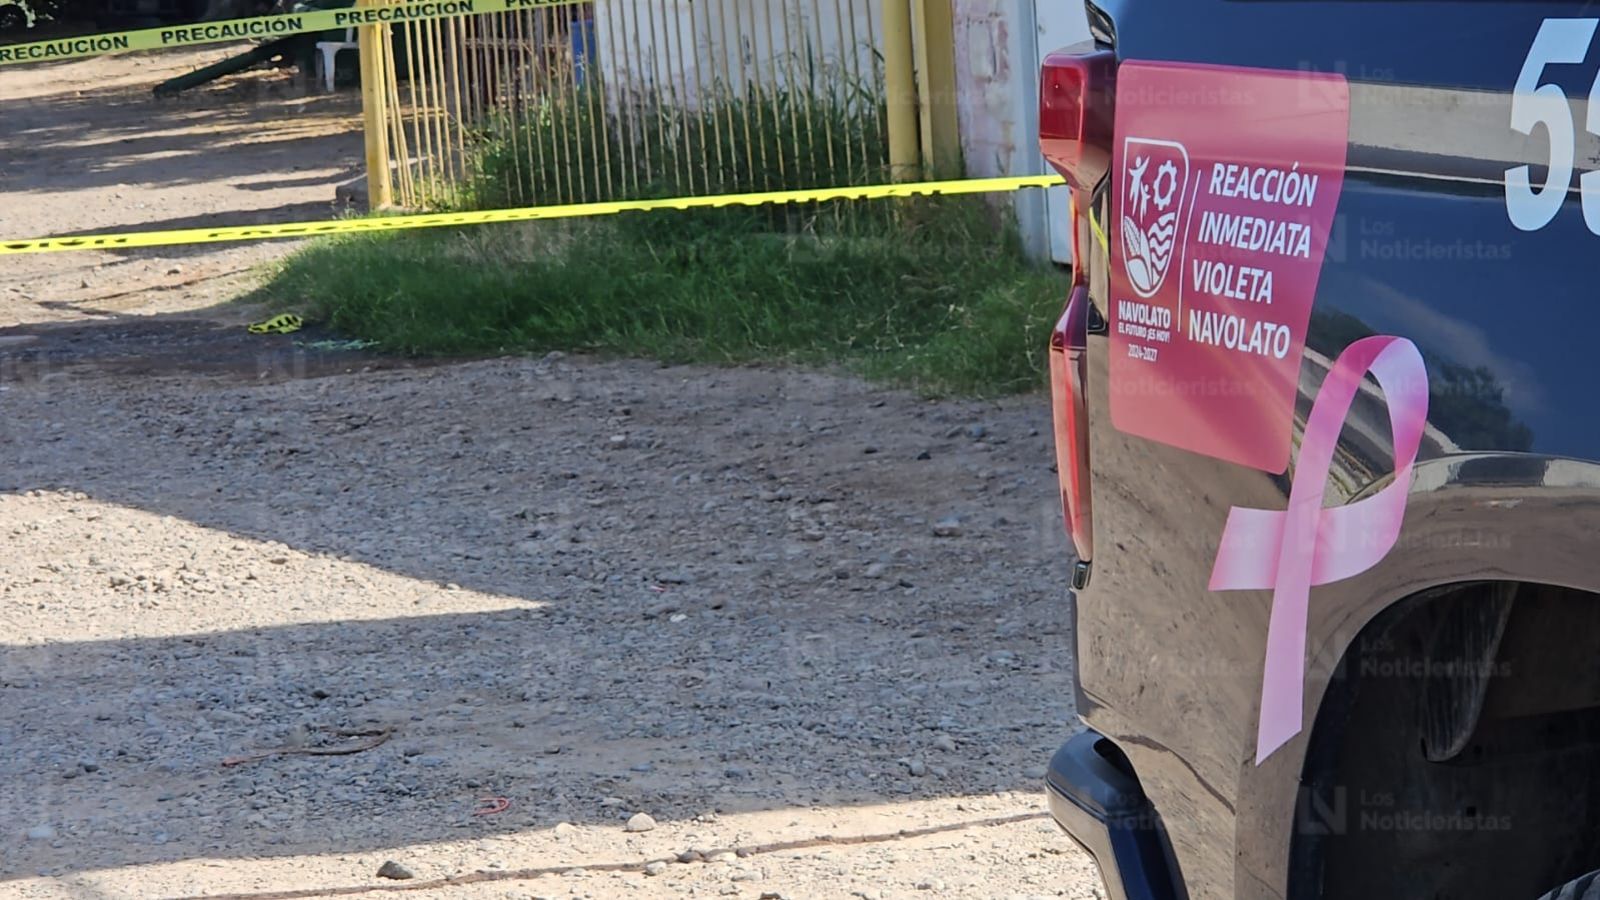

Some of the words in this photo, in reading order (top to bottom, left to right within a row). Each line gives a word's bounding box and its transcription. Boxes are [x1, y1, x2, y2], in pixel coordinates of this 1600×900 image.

[161, 17, 303, 44] PRECAUCIÓN
[1505, 18, 1600, 236] 5
[1209, 161, 1319, 207] REACCIÓN
[1198, 211, 1311, 258] INMEDIATA
[1193, 259, 1273, 304] VIOLETA
[1118, 300, 1171, 329] NAVOLATO
[1188, 309, 1291, 359] NAVOLATO
